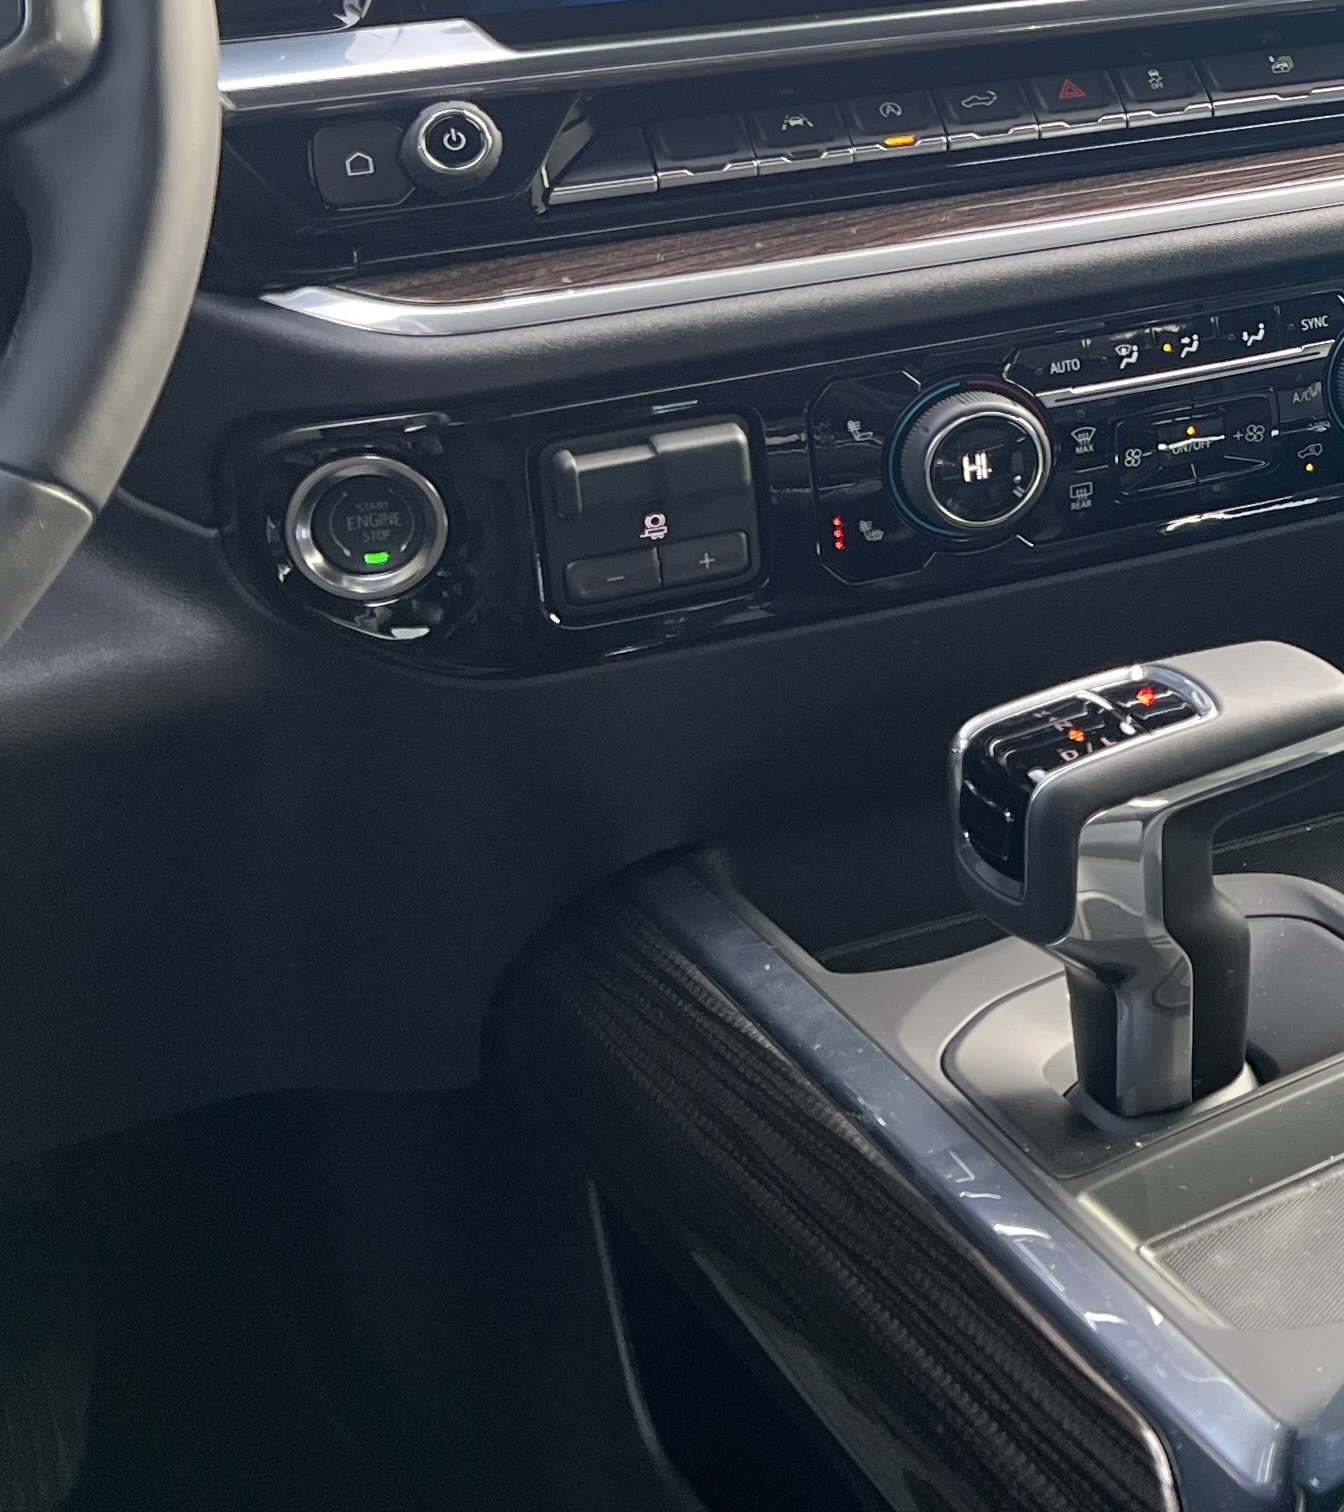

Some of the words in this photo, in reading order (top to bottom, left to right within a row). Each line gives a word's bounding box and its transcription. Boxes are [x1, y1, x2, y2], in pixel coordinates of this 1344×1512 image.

[1300, 314, 1330, 332] SYNC
[1049, 358, 1081, 376] AUTO
[1292, 389, 1313, 405] A/C
[1075, 444, 1095, 455] MAX
[962, 451, 989, 483] HI
[354, 500, 390, 513] START
[1071, 499, 1092, 511] REAR
[346, 511, 403, 532] ENGINE
[362, 528, 392, 544] STOP
